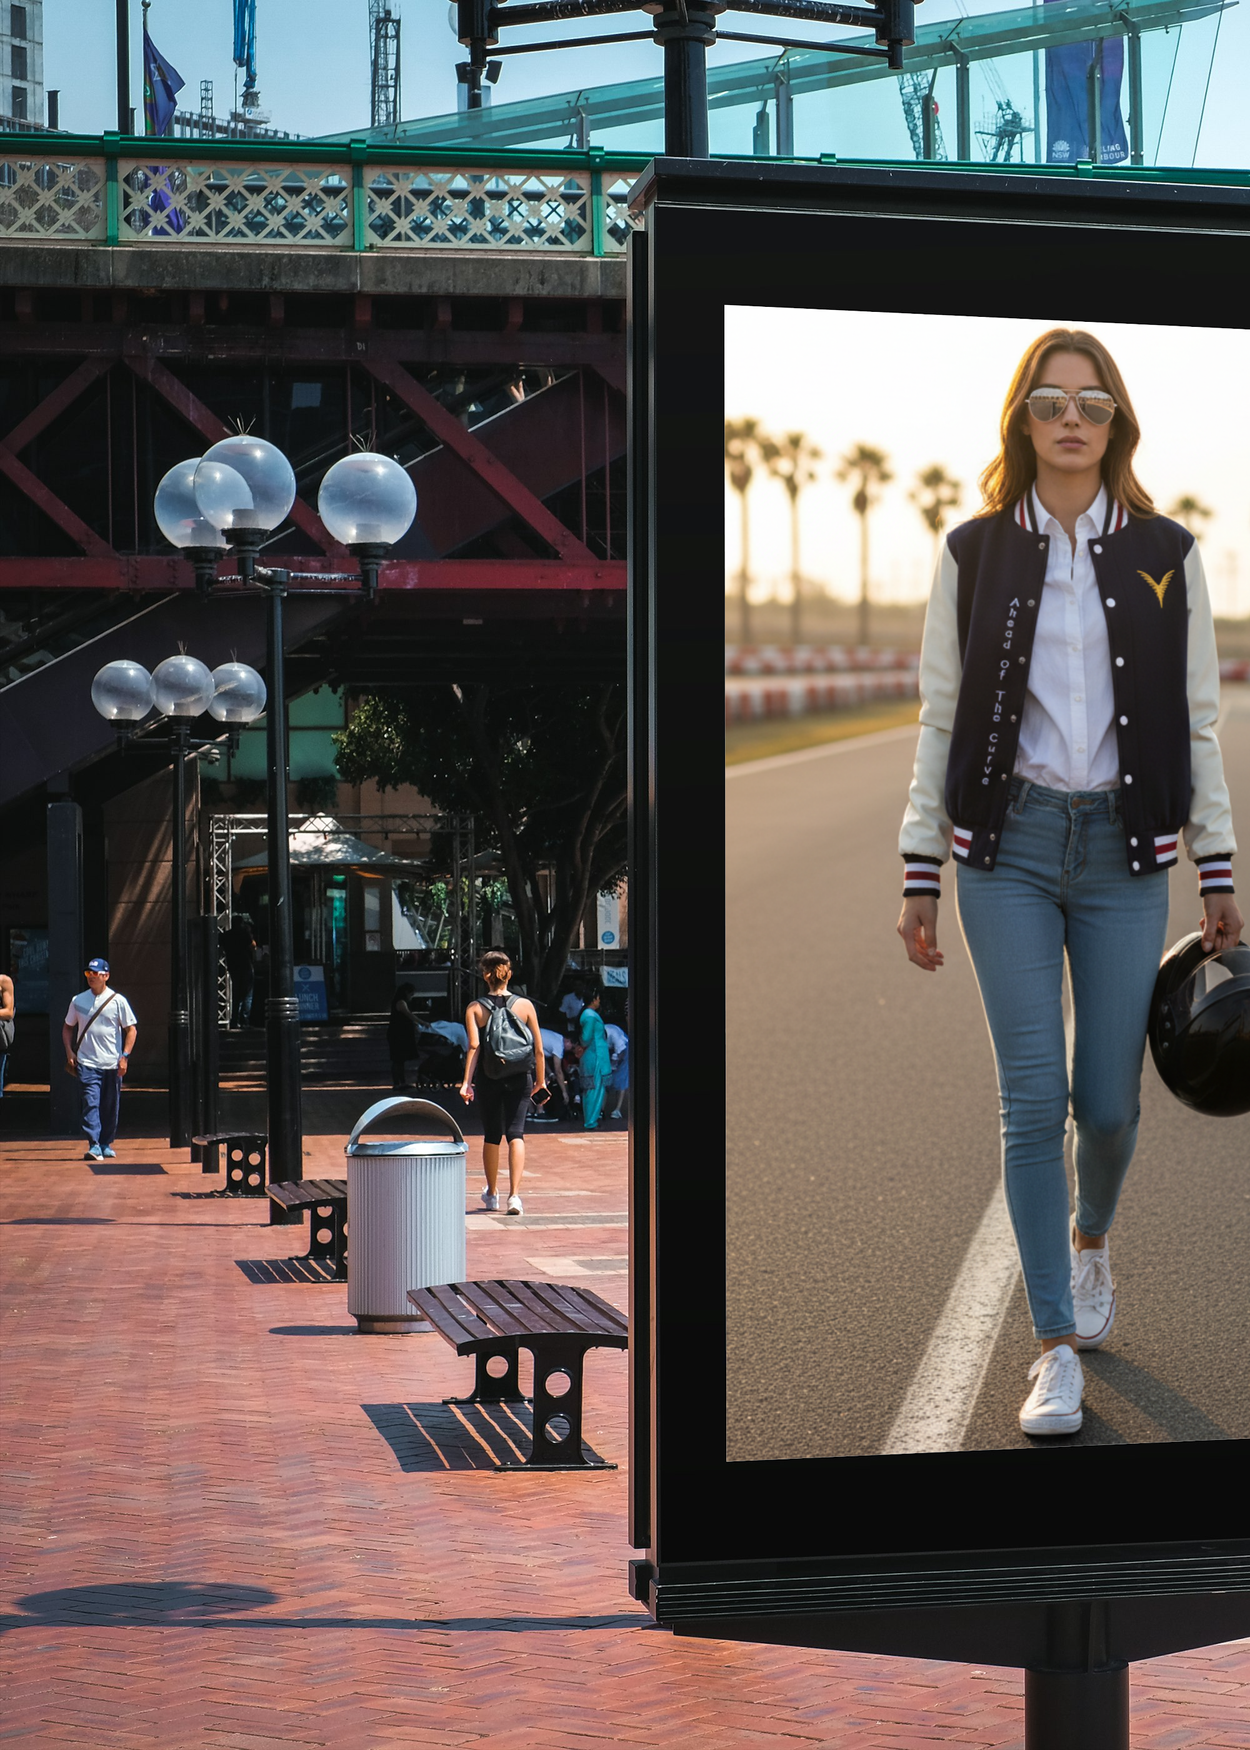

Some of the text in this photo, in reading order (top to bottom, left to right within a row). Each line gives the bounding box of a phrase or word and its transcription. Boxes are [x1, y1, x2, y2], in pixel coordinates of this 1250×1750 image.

[1002, 597, 1020, 650] Ahead
[992, 690, 1006, 722] The
[981, 733, 999, 786] Curve
